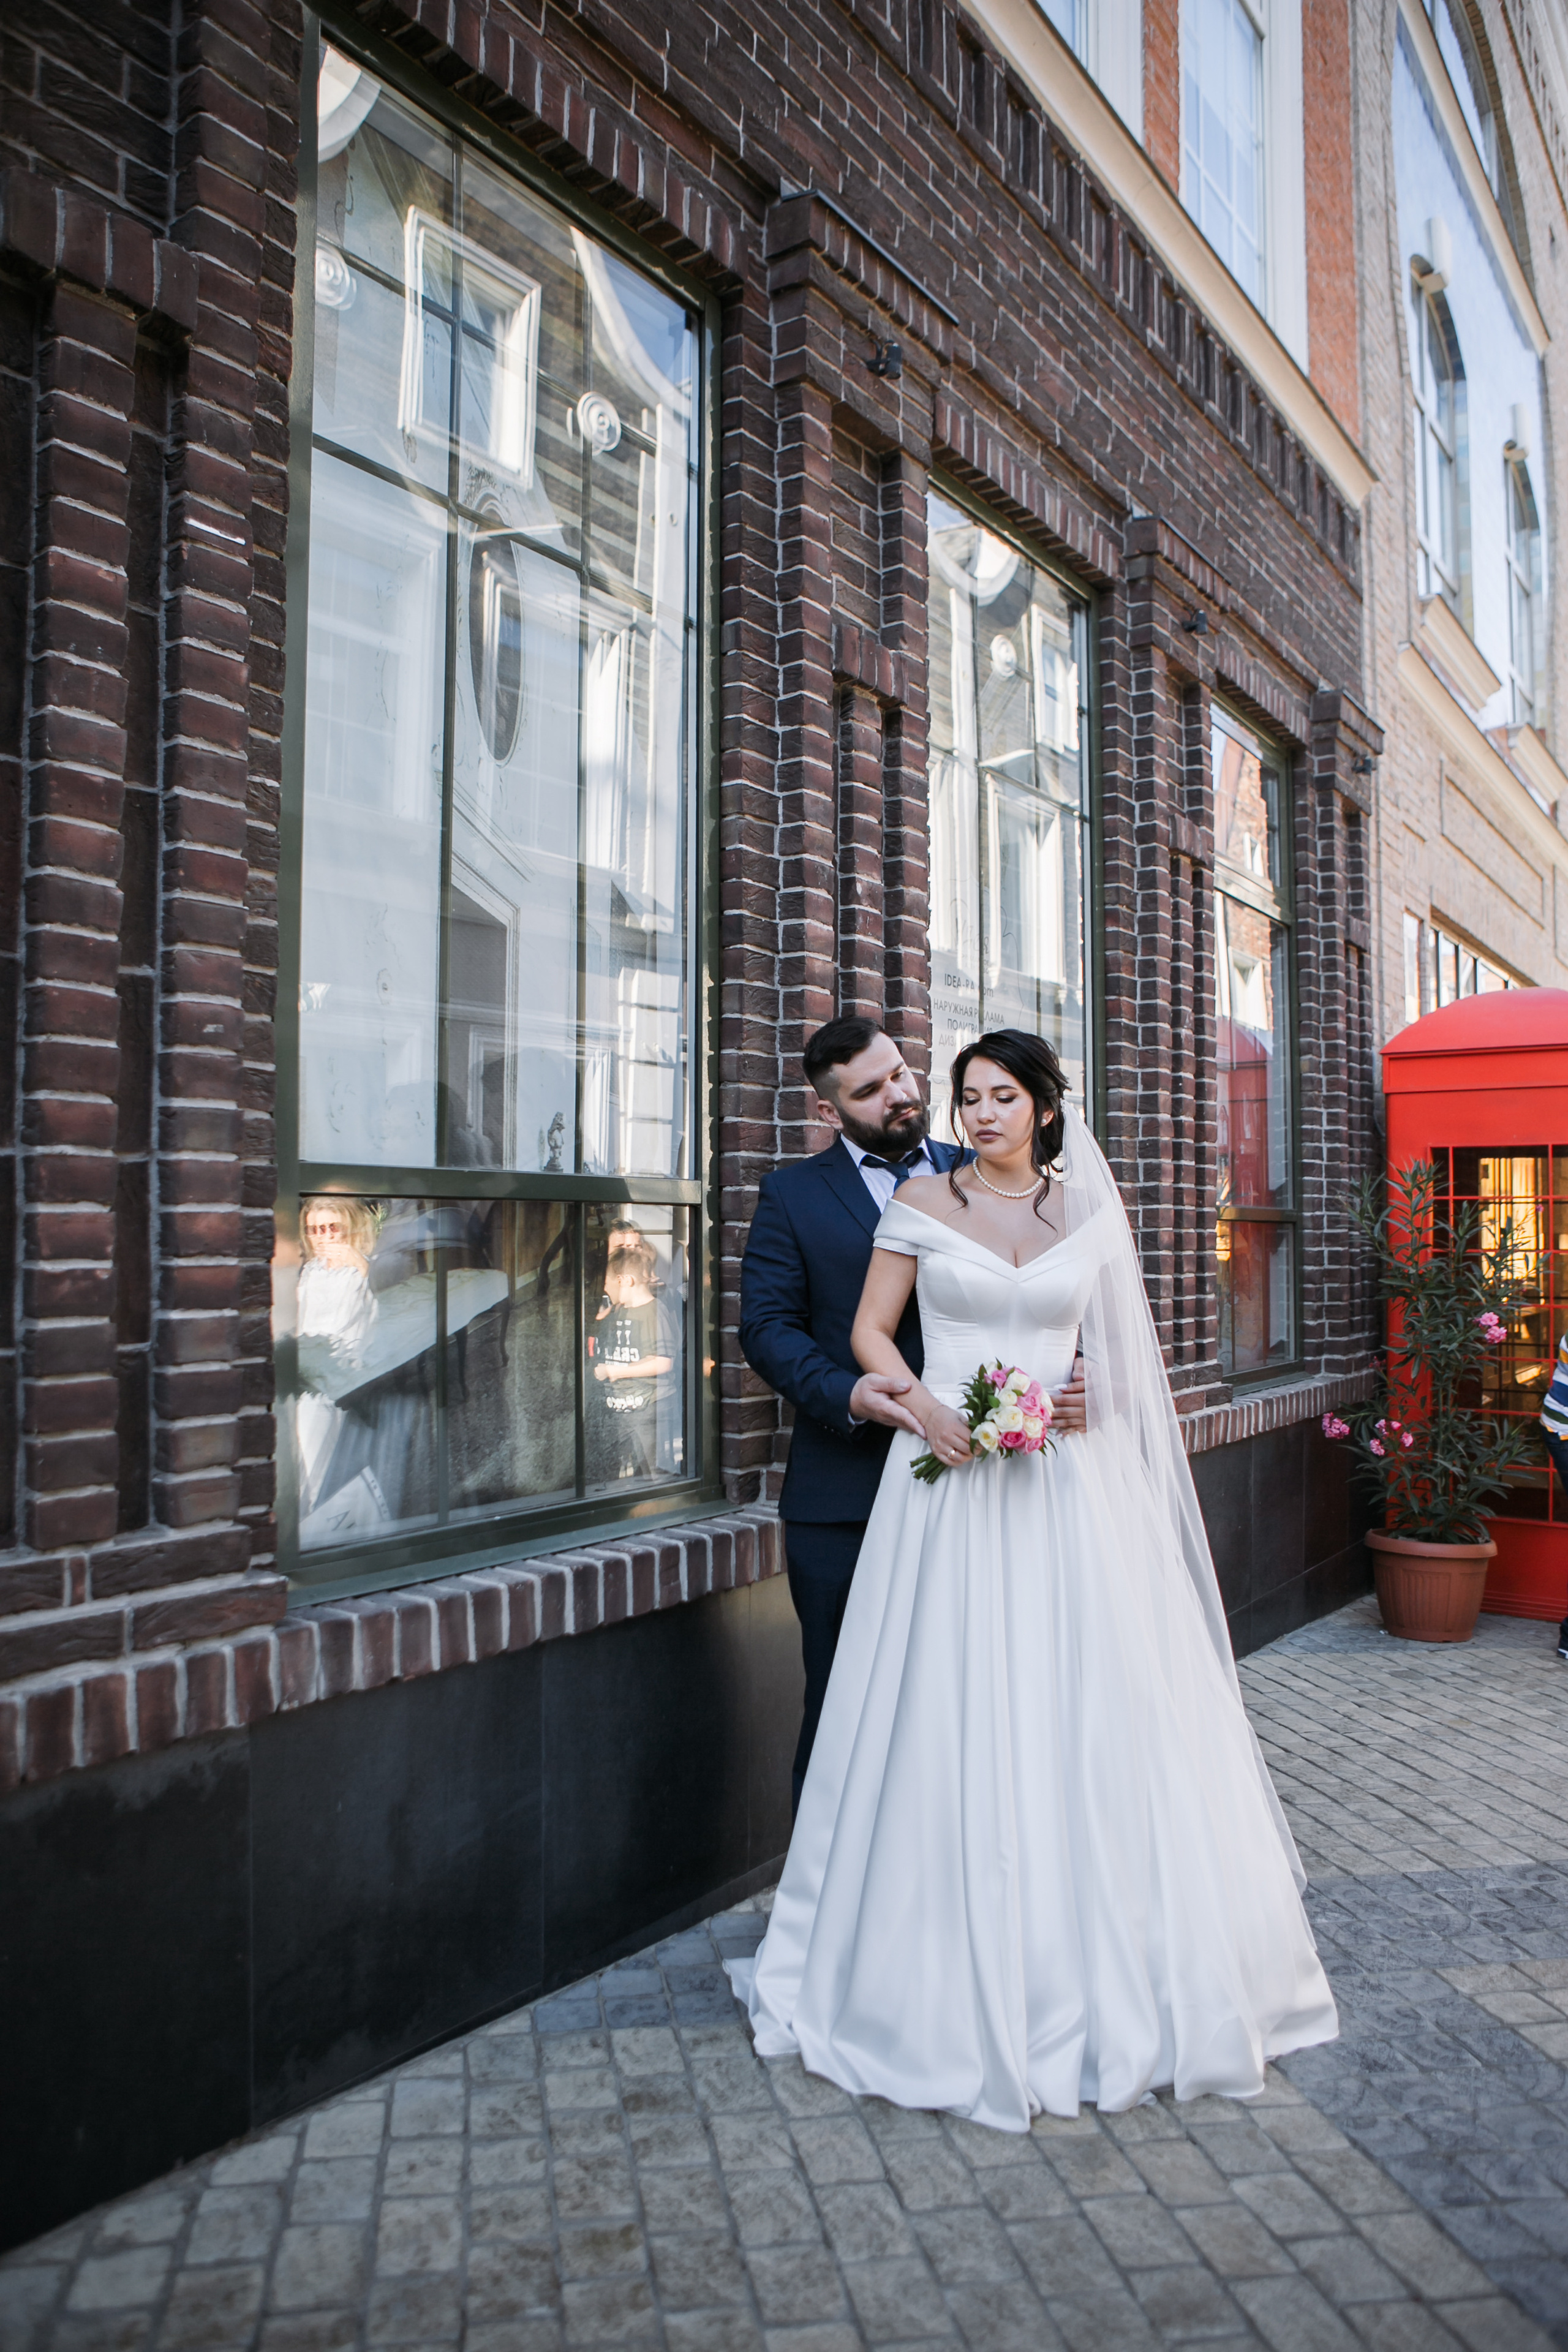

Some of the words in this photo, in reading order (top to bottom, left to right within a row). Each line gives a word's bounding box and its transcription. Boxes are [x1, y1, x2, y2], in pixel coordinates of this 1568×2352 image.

[944, 973, 993, 998] IDEA-RAom
[934, 998, 973, 1017] НАРУЖНАЯ
[974, 1008, 1005, 1025] РЛАМА
[947, 1018, 993, 1035] ПОЛИГРАИЯ
